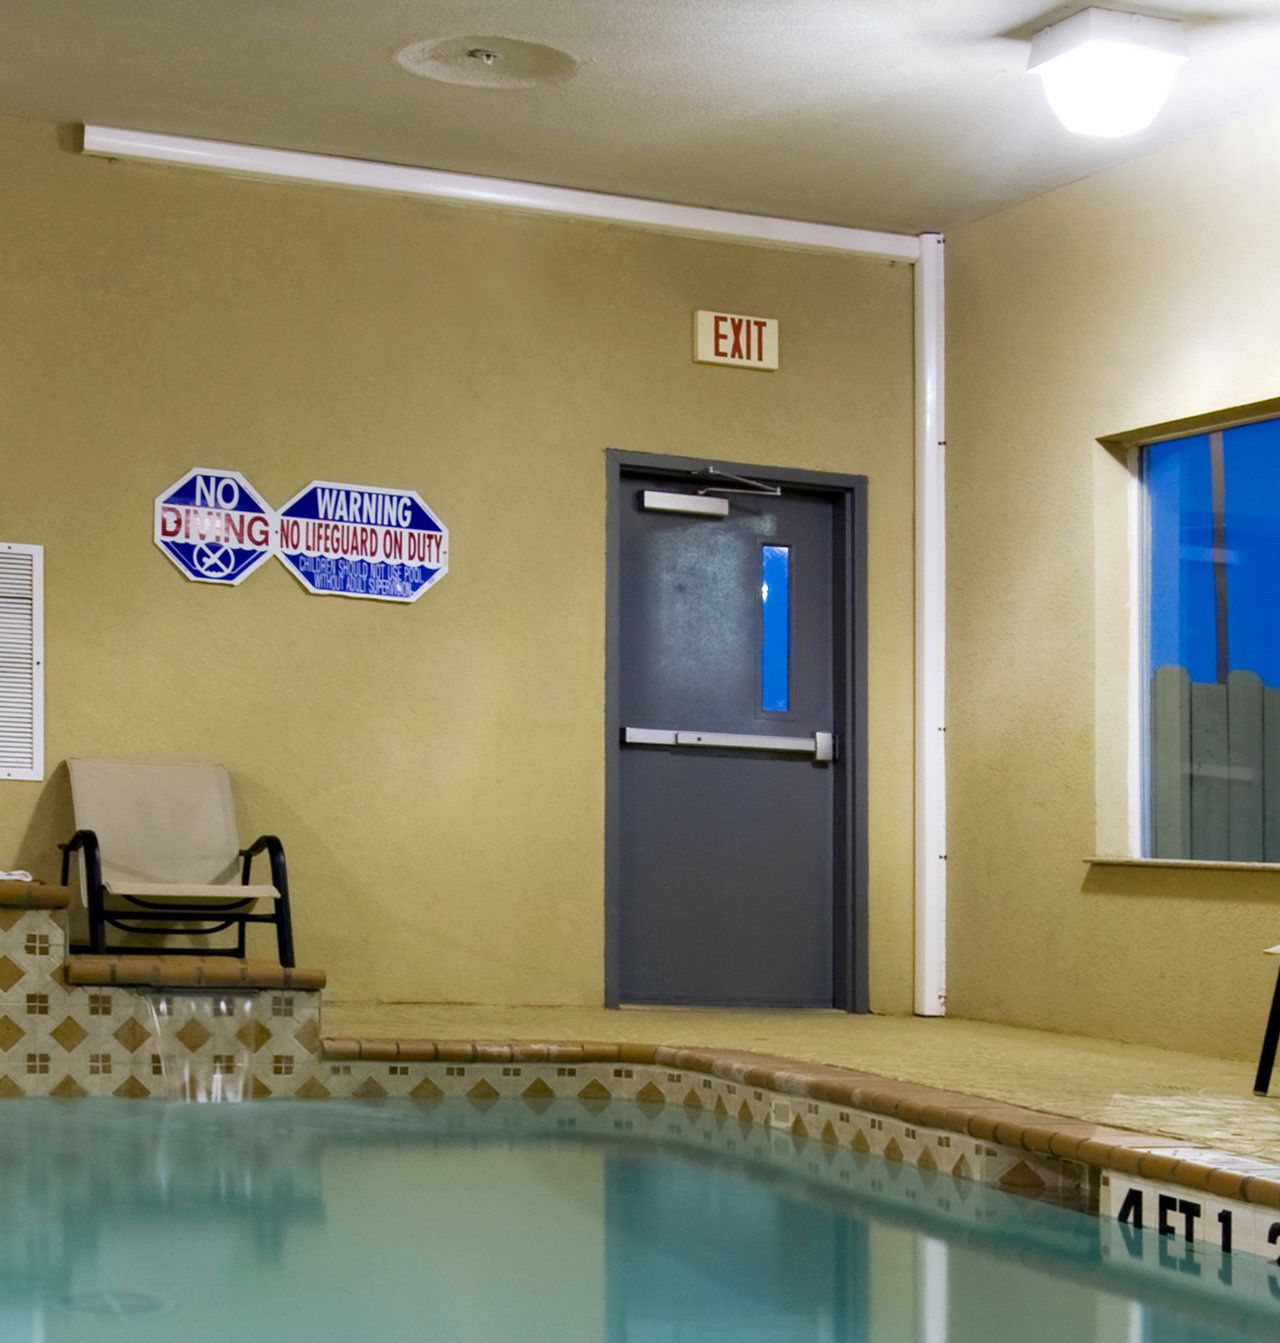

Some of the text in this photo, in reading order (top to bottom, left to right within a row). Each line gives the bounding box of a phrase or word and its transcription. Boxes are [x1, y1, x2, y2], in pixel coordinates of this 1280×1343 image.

[714, 315, 767, 362] EXIT
[195, 475, 239, 509] NO
[317, 488, 412, 528] WARNING
[161, 507, 269, 546] DIVING
[280, 519, 443, 563] NO LIFEGUARD ON DUTY
[299, 556, 335, 576] CHILDREN
[338, 562, 367, 579] SHOULD
[369, 565, 385, 580] NOT
[387, 567, 402, 582] USE
[315, 573, 344, 591] WITHOUT
[346, 578, 367, 593] ADULT
[1117, 1188, 1143, 1229] 4
[1158, 1194, 1201, 1243] FT
[1218, 1209, 1232, 1253] 1
